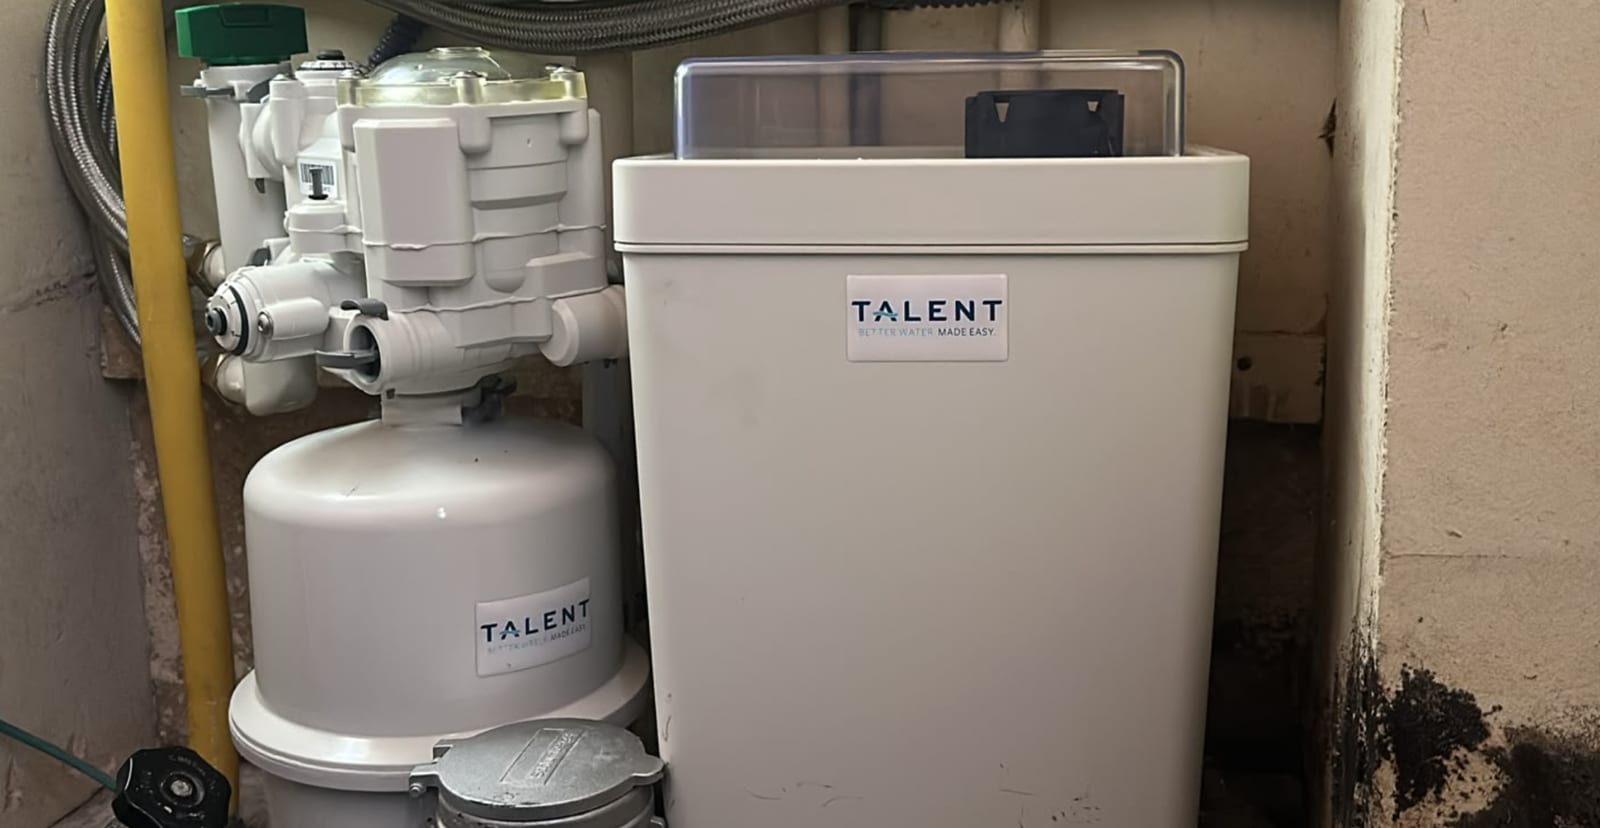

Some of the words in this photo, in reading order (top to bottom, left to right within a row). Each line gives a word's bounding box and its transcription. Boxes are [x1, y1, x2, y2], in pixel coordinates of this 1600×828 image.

[851, 300, 1003, 322] TALENT
[858, 328, 898, 337] BETTER
[900, 328, 934, 337] WATER
[938, 327, 967, 337] MADE
[480, 598, 590, 643] TALENT
